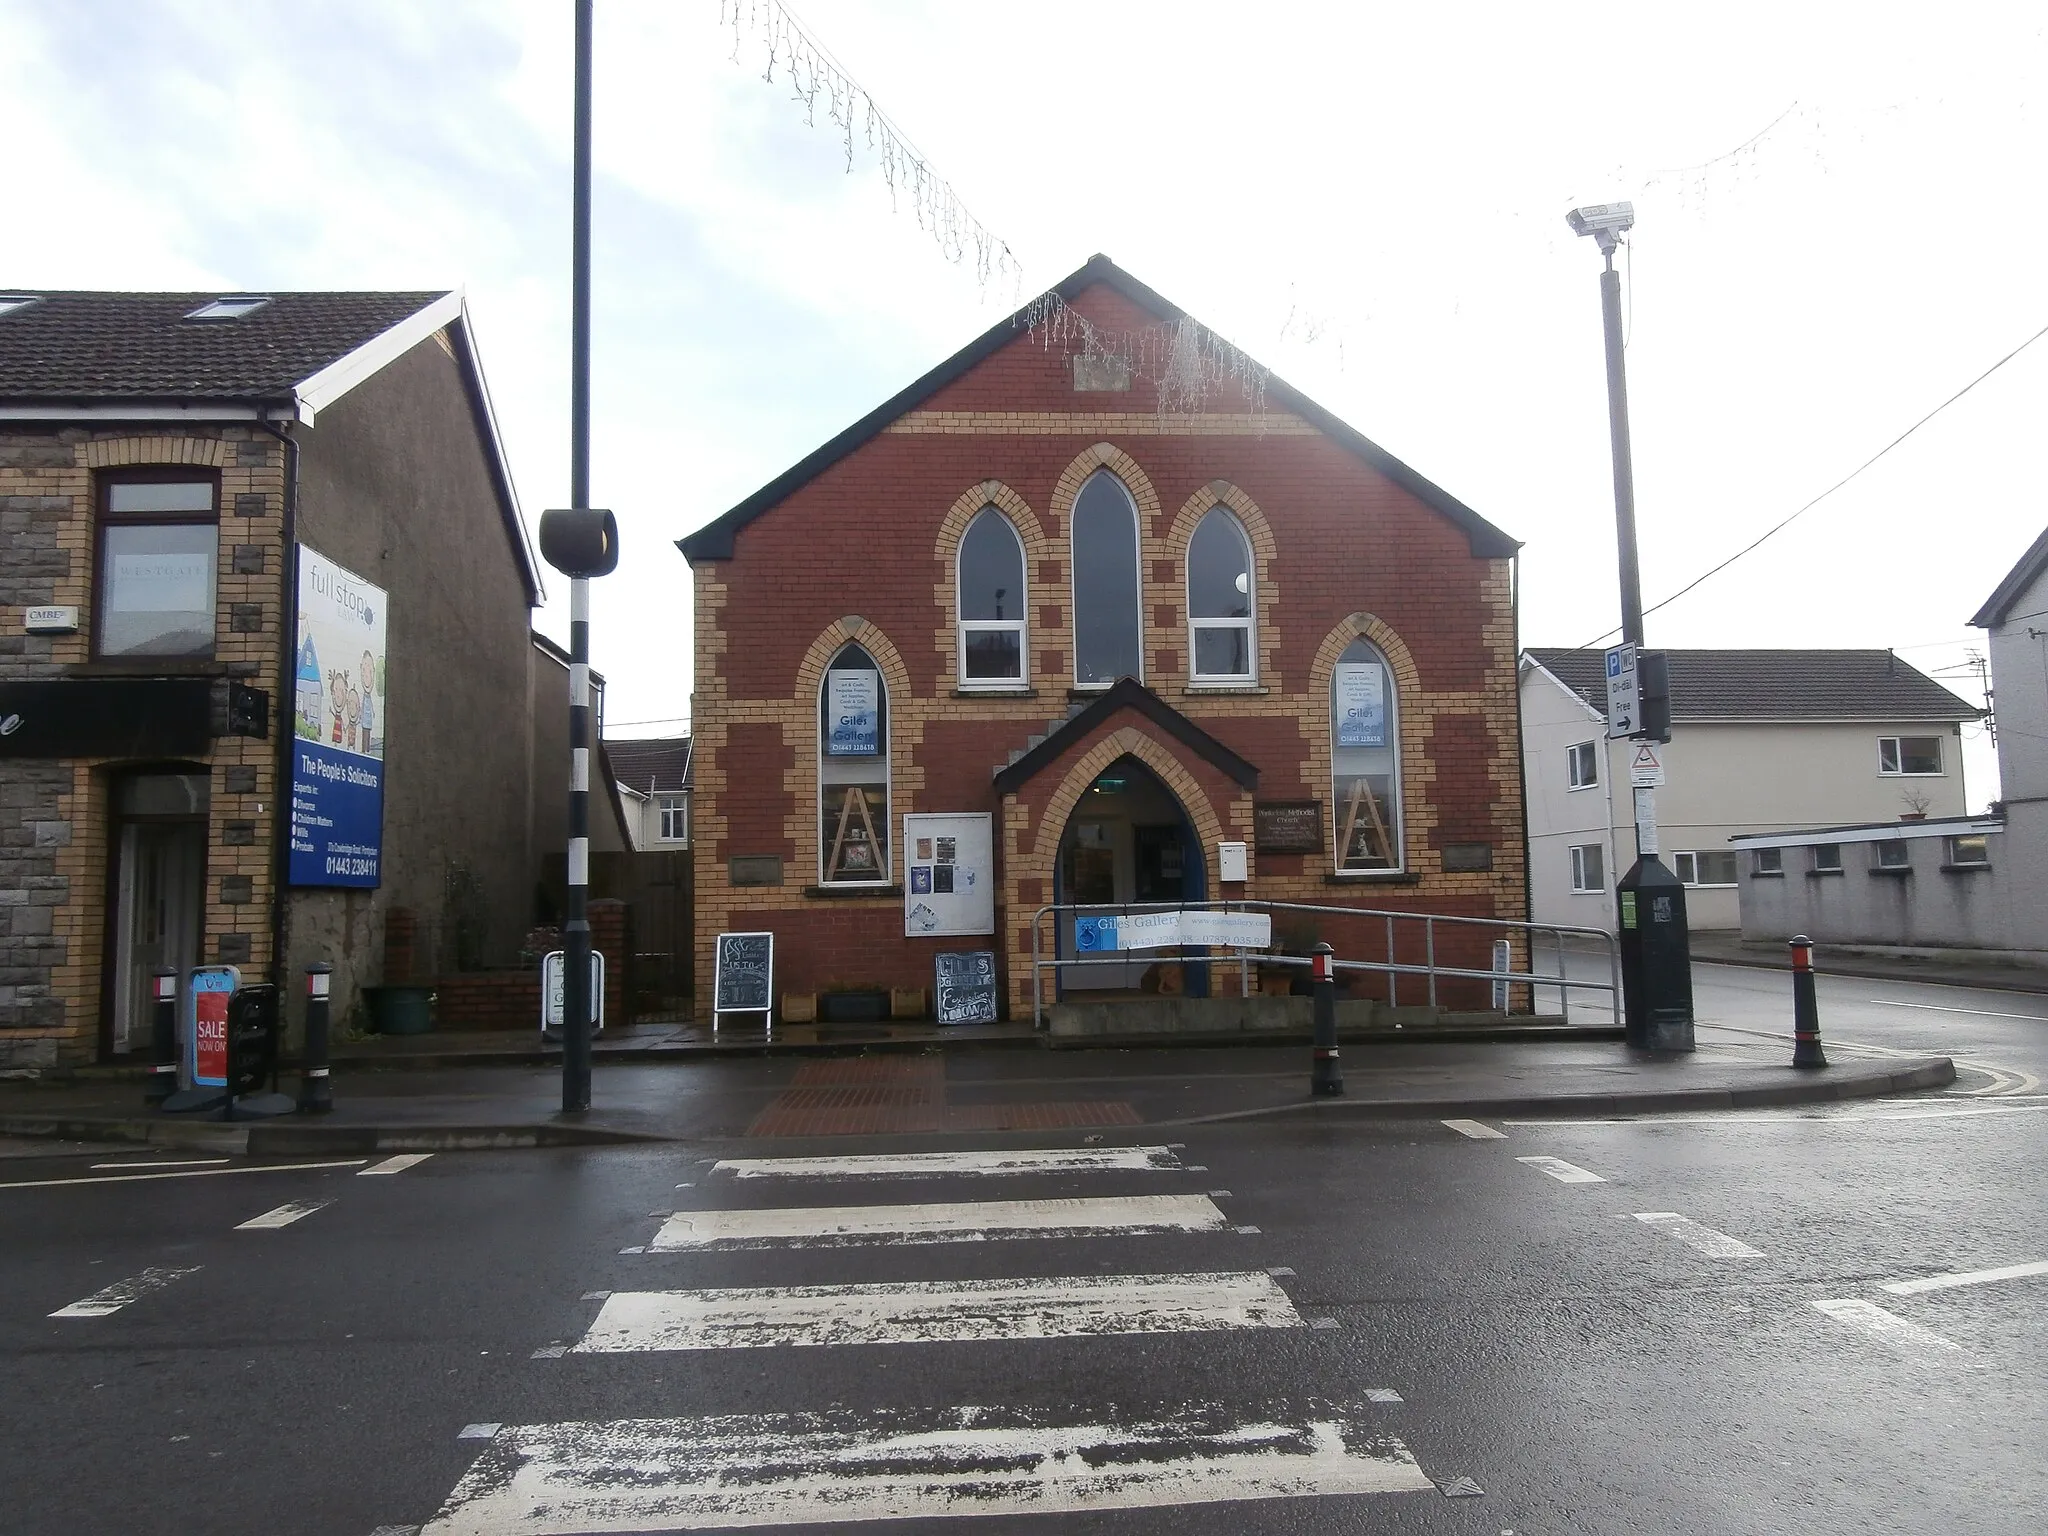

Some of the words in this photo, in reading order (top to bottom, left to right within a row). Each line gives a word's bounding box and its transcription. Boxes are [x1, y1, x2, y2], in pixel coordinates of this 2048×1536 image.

[310, 565, 334, 600] full
[1347, 708, 1373, 718] Giles
[1616, 702, 1631, 713] Free
[840, 715, 867, 726] Giles
[302, 754, 316, 775] The
[317, 758, 347, 783] People's
[347, 765, 378, 788] Solicitors
[293, 781, 313, 794] Experts
[297, 813, 317, 825] Children
[326, 857, 351, 875] 01443
[351, 858, 377, 876] 238411
[1097, 917, 1130, 930] Giles
[1134, 915, 1181, 929] Gallery
[198, 1021, 226, 1039] SALE
[197, 1041, 214, 1052] NOW
